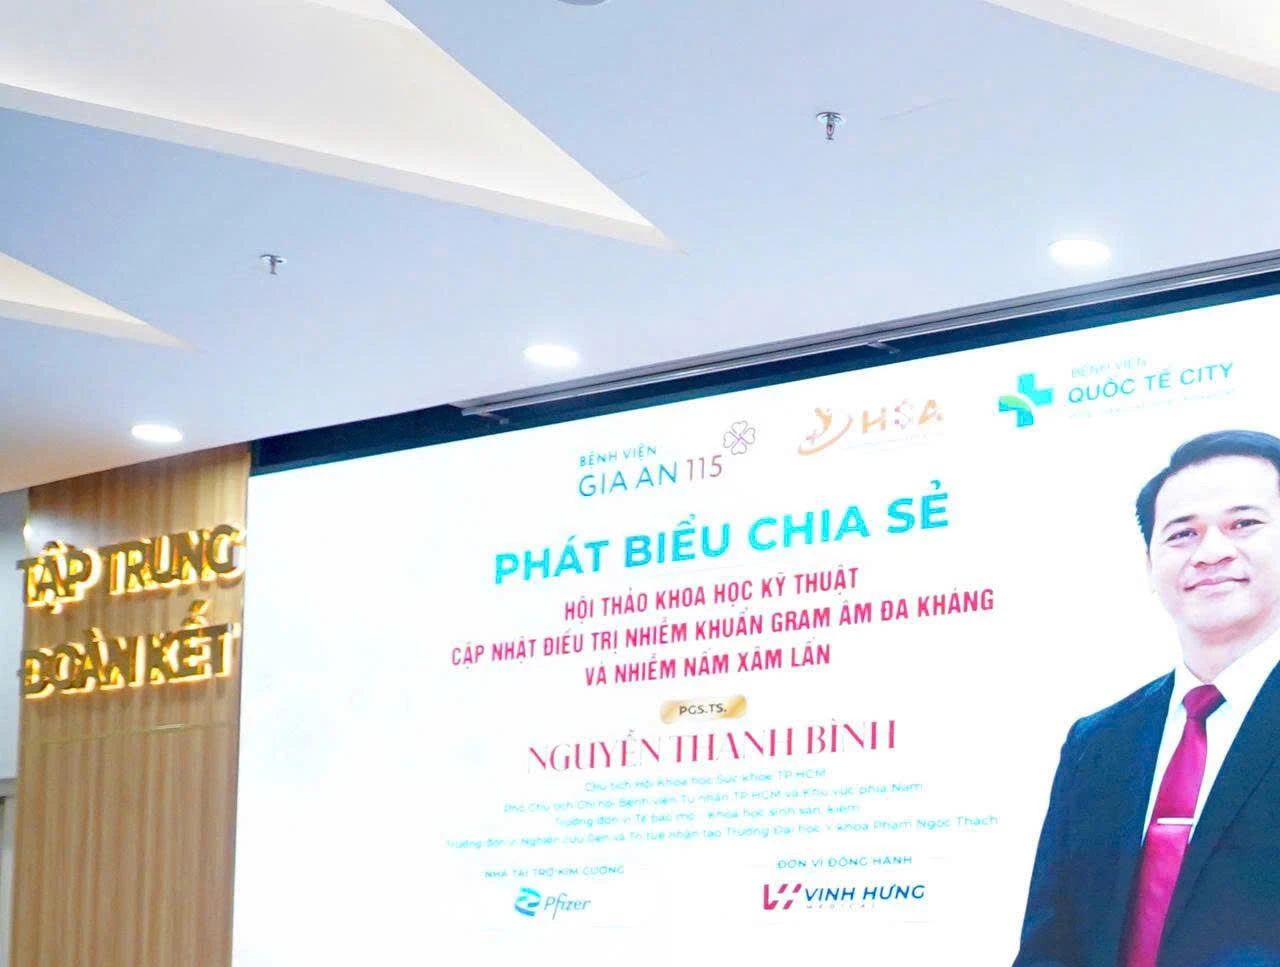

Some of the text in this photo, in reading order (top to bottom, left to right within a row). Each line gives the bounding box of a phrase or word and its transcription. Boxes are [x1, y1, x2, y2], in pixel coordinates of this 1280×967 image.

[1180, 362, 1234, 386] CITY
[579, 444, 657, 469] BỆNH VIỆN
[578, 454, 723, 496] GIA AN 115
[495, 479, 949, 585] PHÁT BIỂU CHIA SẺ
[564, 595, 594, 625] HỘI
[602, 586, 648, 617] THẢO
[655, 586, 706, 611] KHOA
[713, 580, 753, 608] HỌC
[794, 564, 859, 596] THUẬT
[771, 607, 831, 633] GRAM
[838, 599, 872, 626] ÂM
[880, 598, 909, 622] ĐA
[737, 645, 782, 673] XÂM
[679, 703, 727, 716] PGS.TS.
[543, 892, 592, 920] Pfizer
[805, 884, 927, 902] VINH HƯNG
